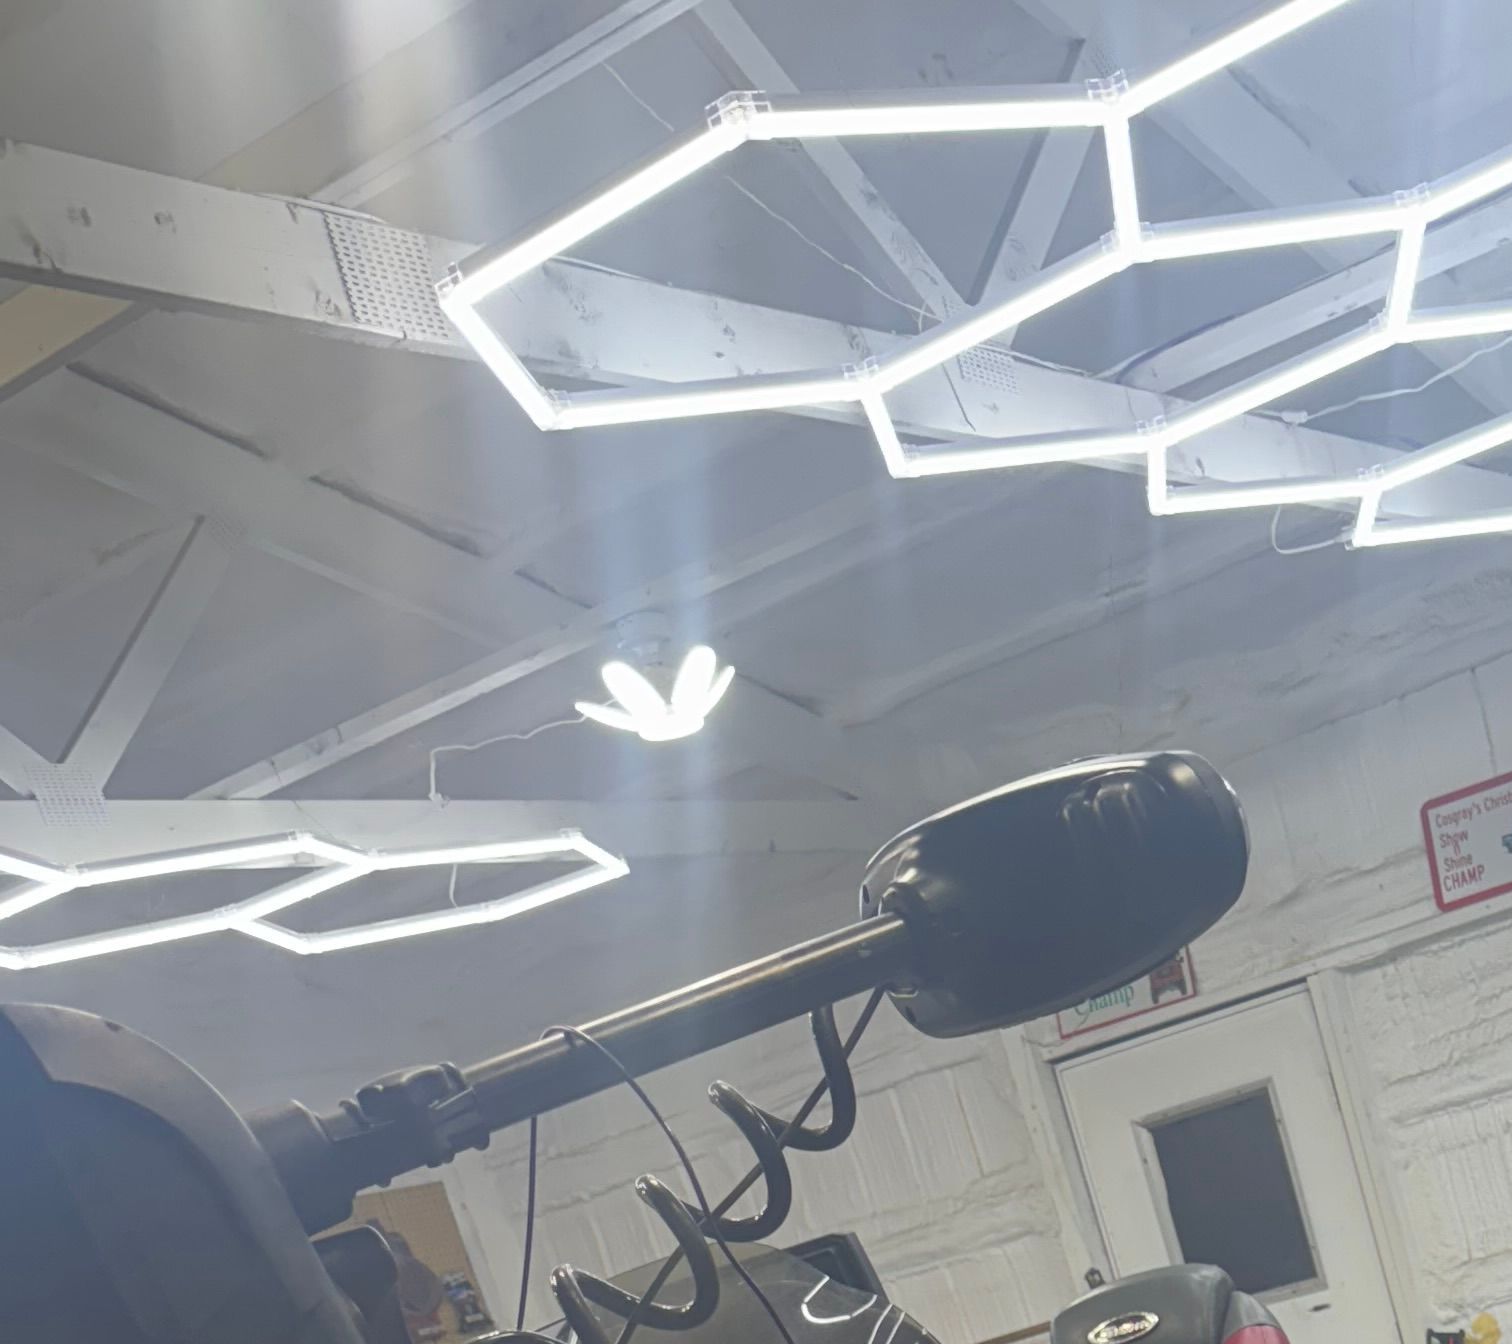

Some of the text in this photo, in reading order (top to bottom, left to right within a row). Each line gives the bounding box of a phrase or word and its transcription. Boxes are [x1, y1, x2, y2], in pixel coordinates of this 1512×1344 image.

[1435, 802, 1482, 828] Cosgray's
[1439, 829, 1468, 850] Show
[1443, 853, 1473, 873] Shine
[1443, 864, 1485, 892] CHAMP
